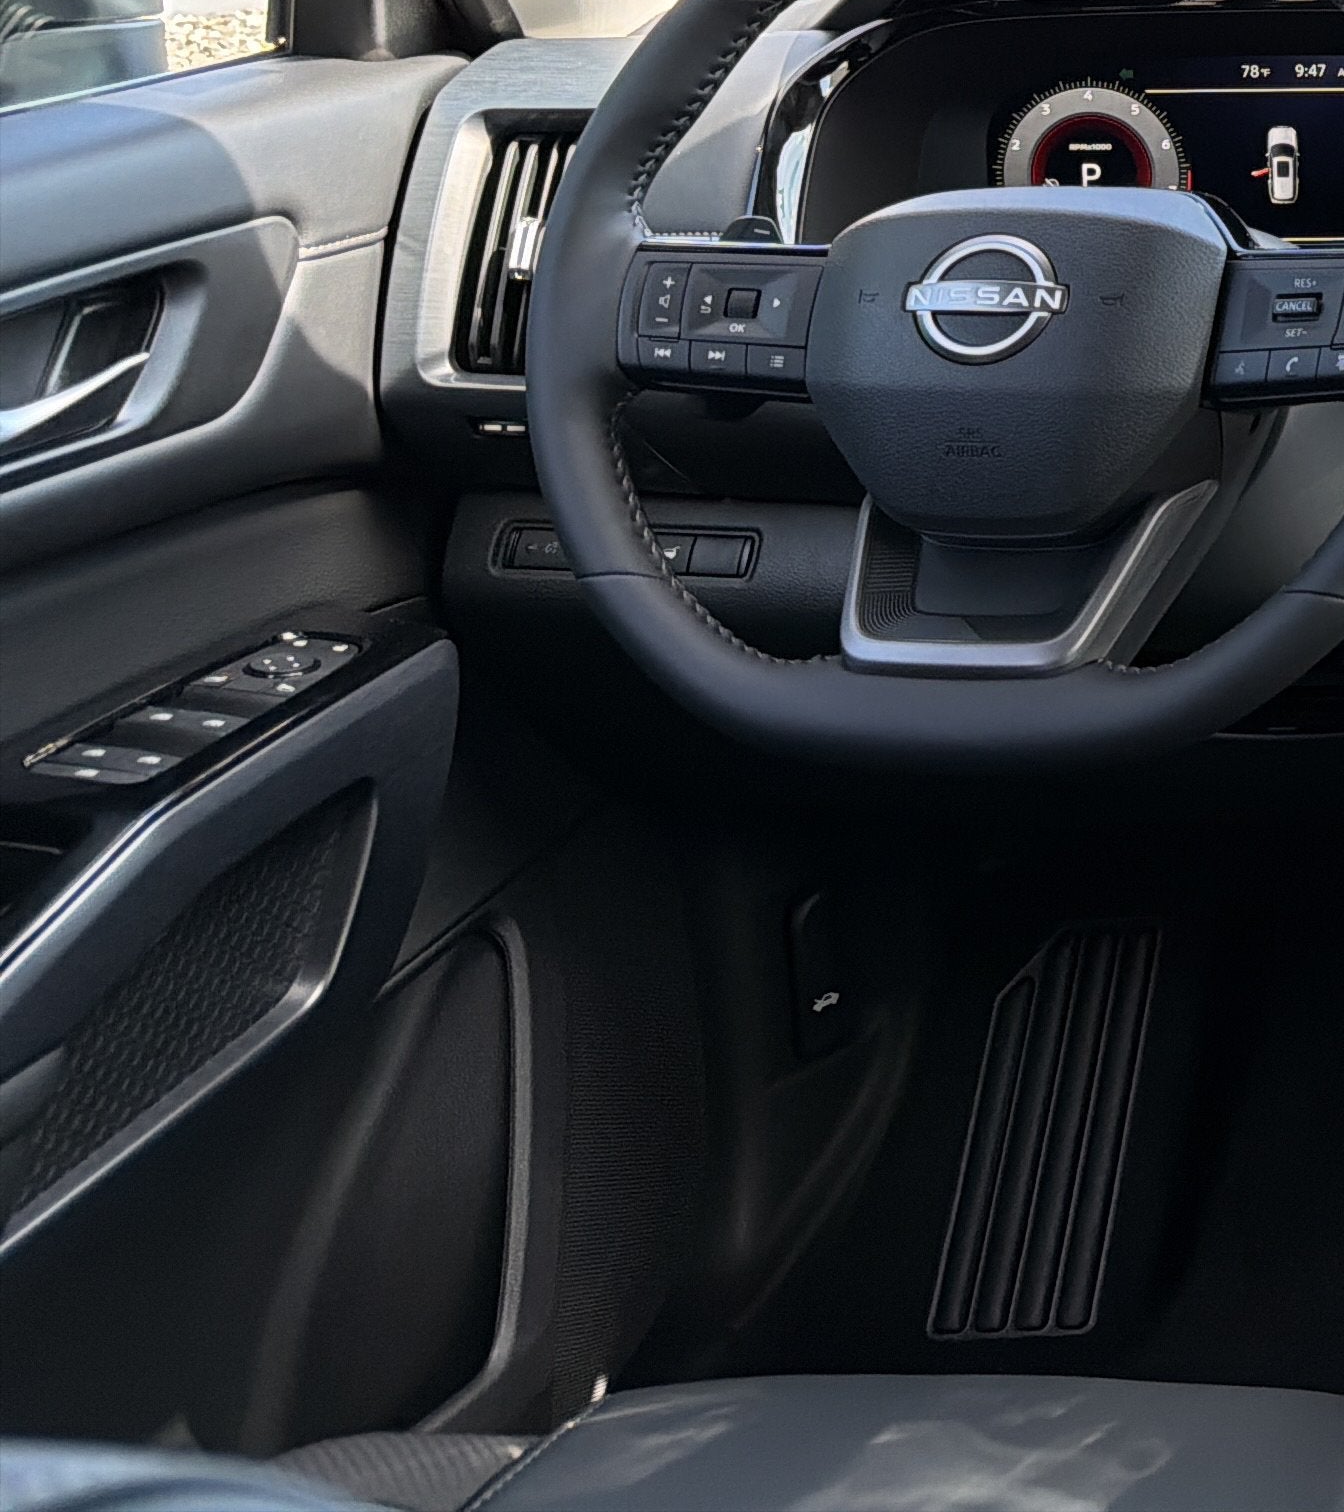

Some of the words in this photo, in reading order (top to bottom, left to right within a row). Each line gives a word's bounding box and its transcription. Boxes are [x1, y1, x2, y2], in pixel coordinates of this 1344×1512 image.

[1294, 63, 1327, 78] 9:47
[1083, 90, 1093, 101] 4
[1041, 104, 1051, 115] 3
[1131, 104, 1140, 115] 5
[1011, 140, 1021, 151] 2
[1161, 139, 1171, 150] 6
[1081, 163, 1102, 187] P
[909, 286, 1063, 310] NISSAN
[1275, 301, 1313, 312] CANCEL
[729, 323, 746, 333] OK
